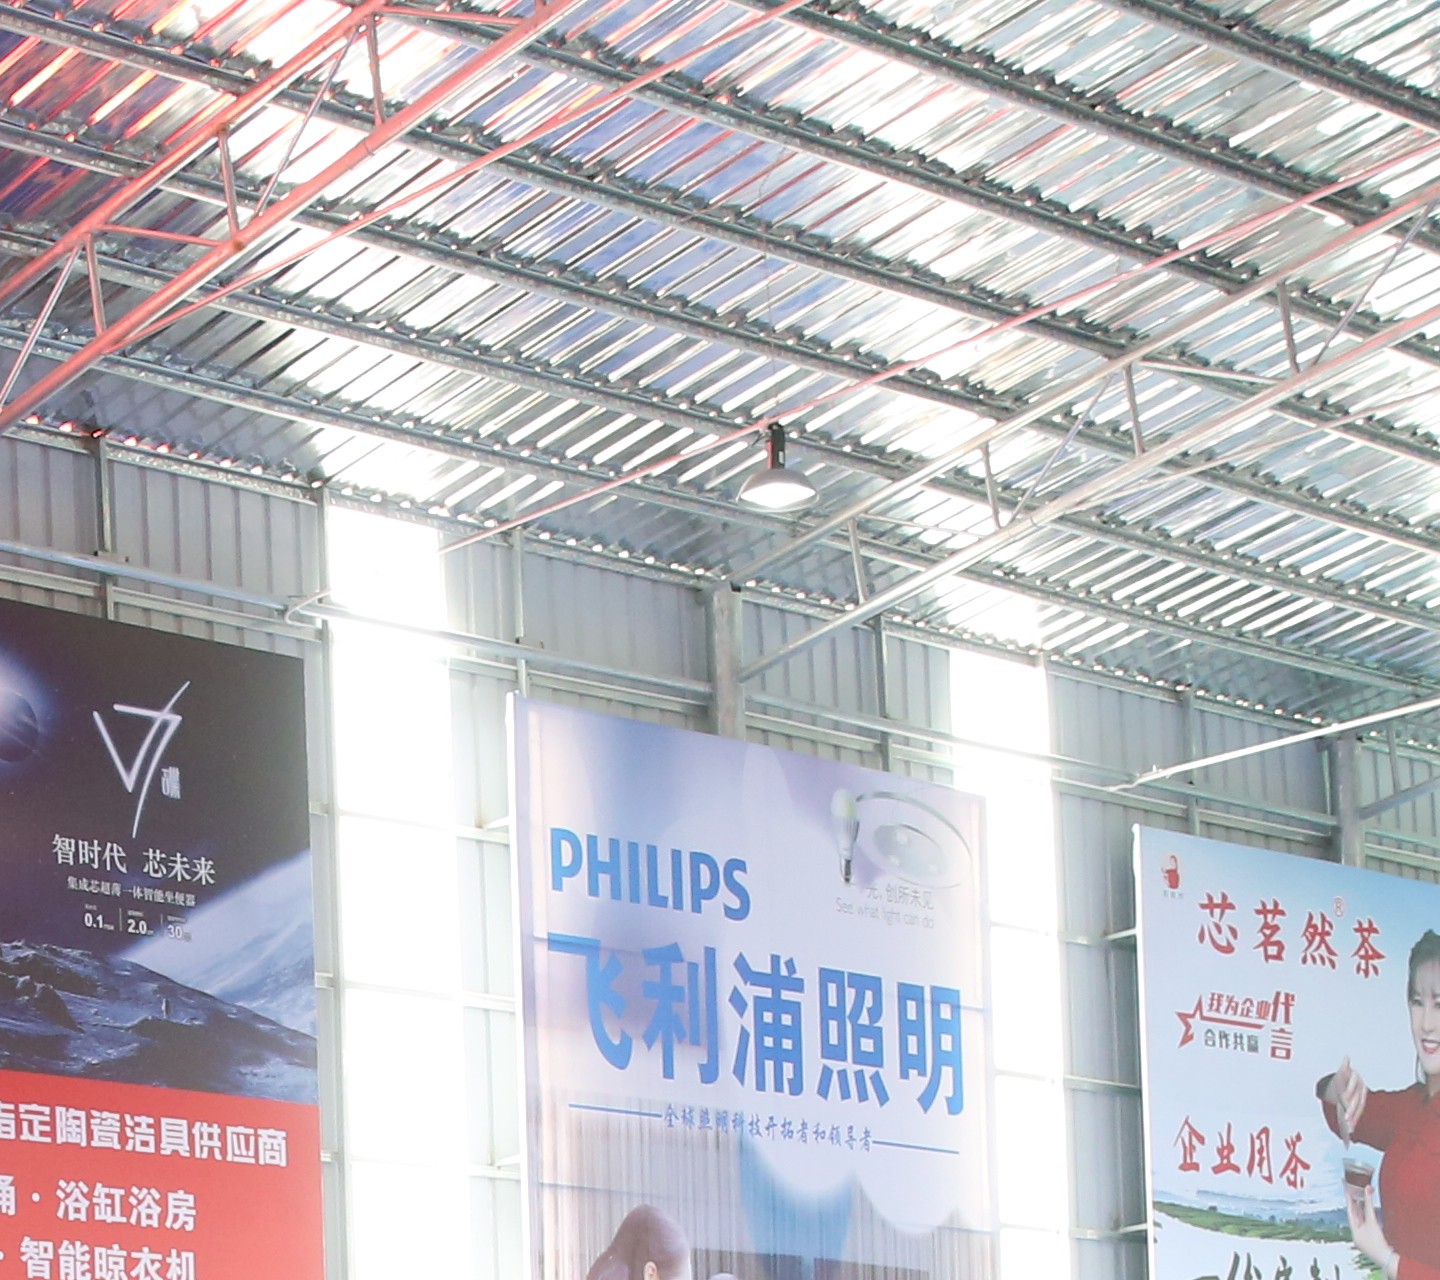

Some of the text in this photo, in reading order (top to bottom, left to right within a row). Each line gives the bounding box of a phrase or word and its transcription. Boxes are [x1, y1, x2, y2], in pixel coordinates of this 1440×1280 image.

[51, 833, 217, 886] 智时代 芯未来
[549, 827, 752, 922] PHILIPS
[547, 932, 966, 1116] 飞利浦照明
